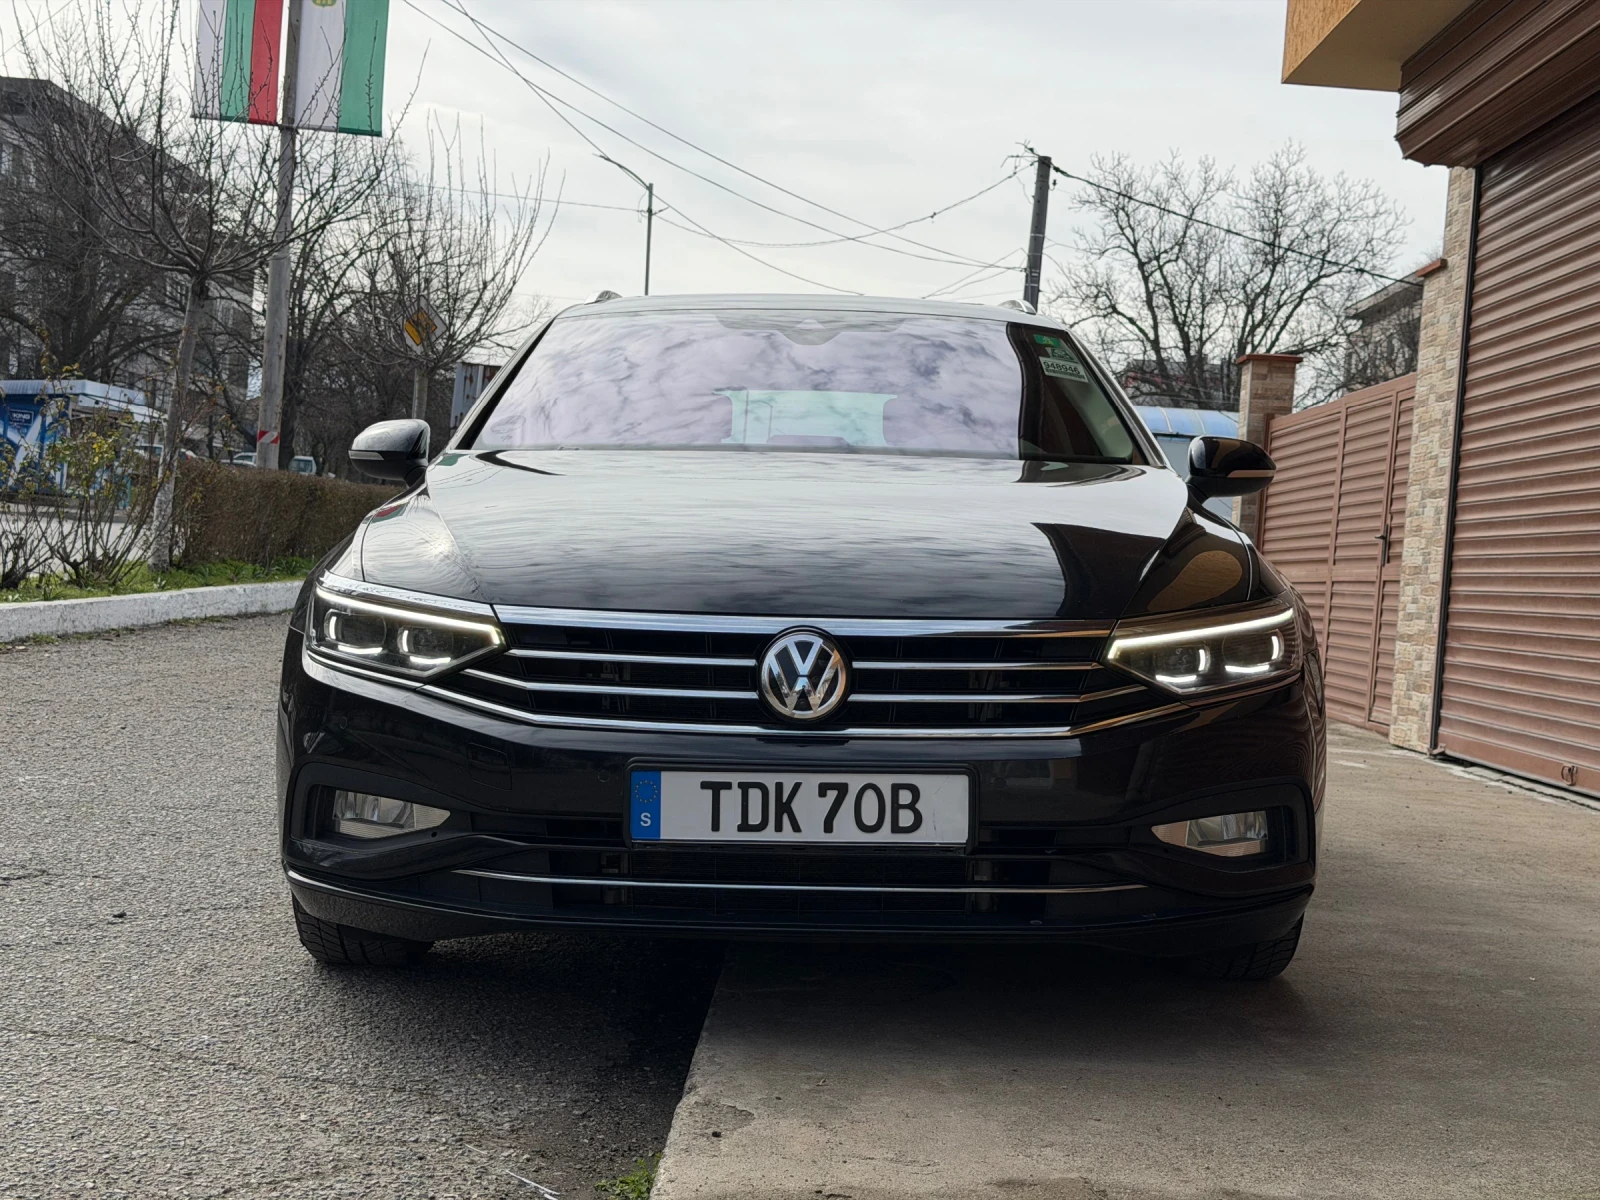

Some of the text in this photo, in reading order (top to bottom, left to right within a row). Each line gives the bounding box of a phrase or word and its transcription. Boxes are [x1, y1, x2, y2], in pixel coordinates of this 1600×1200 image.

[640, 812, 652, 827] S
[700, 781, 924, 834] TDK 70B
